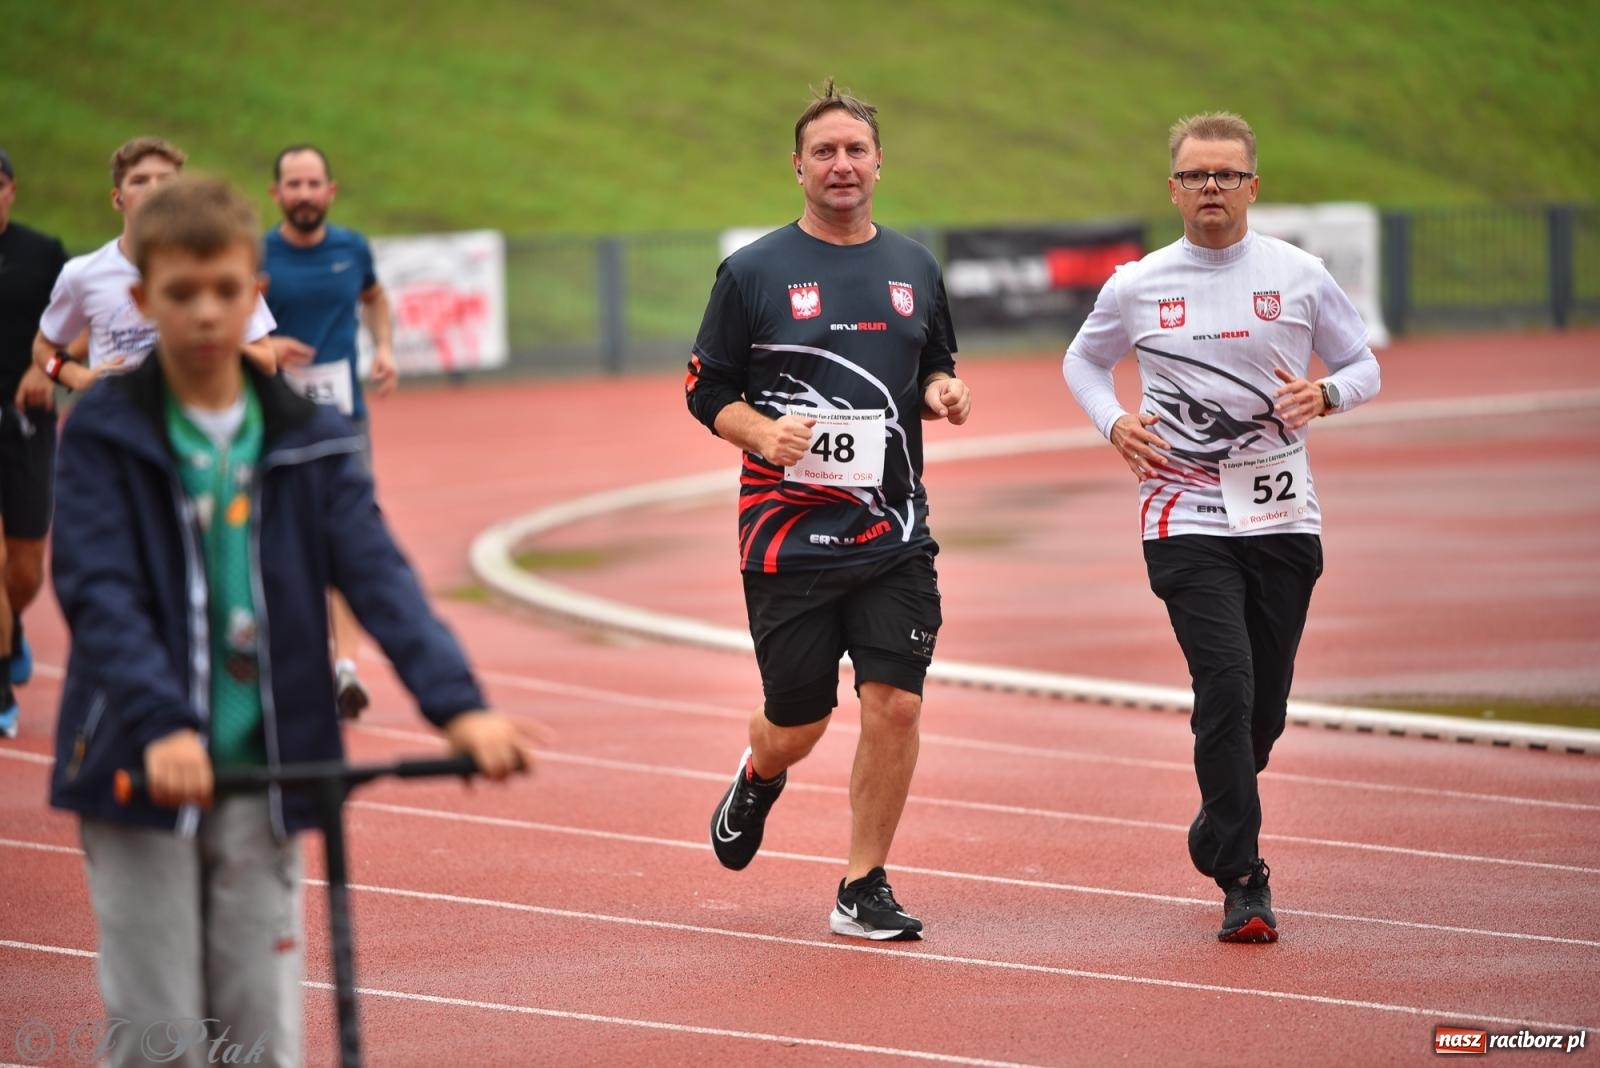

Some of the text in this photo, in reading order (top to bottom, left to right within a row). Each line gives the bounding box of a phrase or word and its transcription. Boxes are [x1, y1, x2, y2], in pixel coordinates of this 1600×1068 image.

[788, 281, 818, 289] POLSKA
[810, 432, 855, 463] 48
[804, 469, 844, 480] Racibórz
[1253, 470, 1296, 504] 52
[1250, 510, 1288, 523] Racibórz
